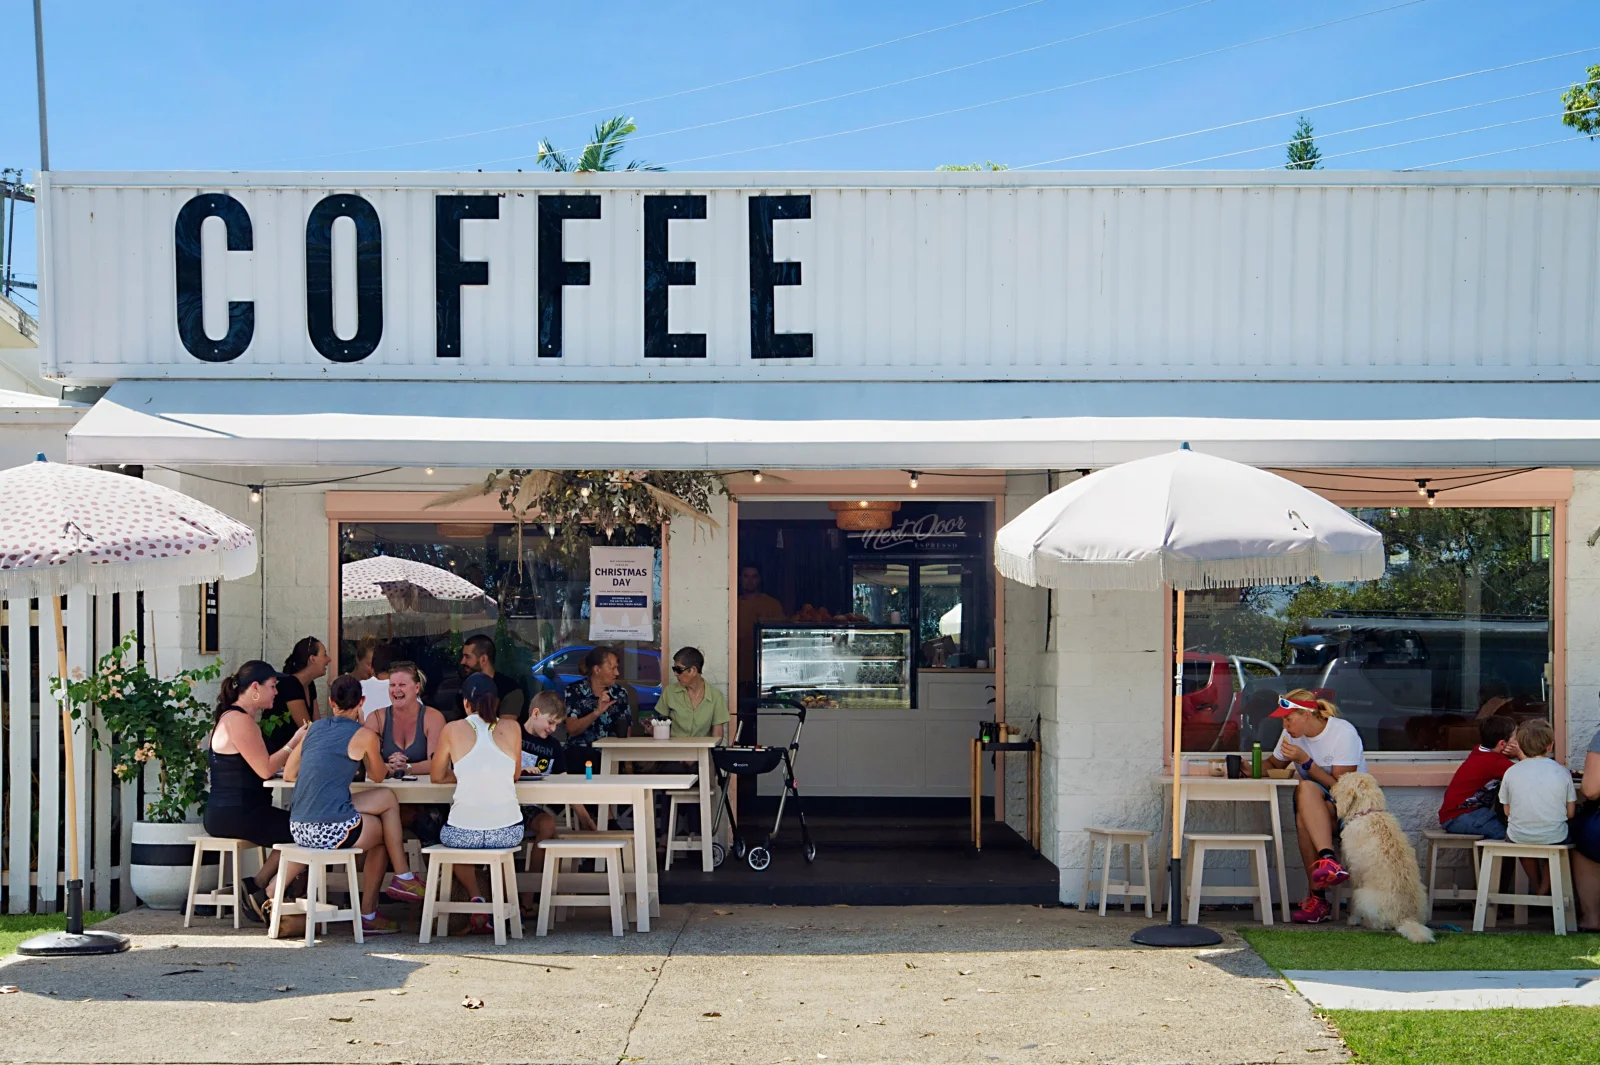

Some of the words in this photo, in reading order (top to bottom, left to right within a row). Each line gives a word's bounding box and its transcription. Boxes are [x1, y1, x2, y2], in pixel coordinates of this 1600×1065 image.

[174, 193, 814, 363] COFFEE
[861, 519, 914, 550] Next
[913, 514, 966, 540] Door
[595, 568, 647, 576] CHRISTMAS
[522, 740, 554, 756] ATMAN
